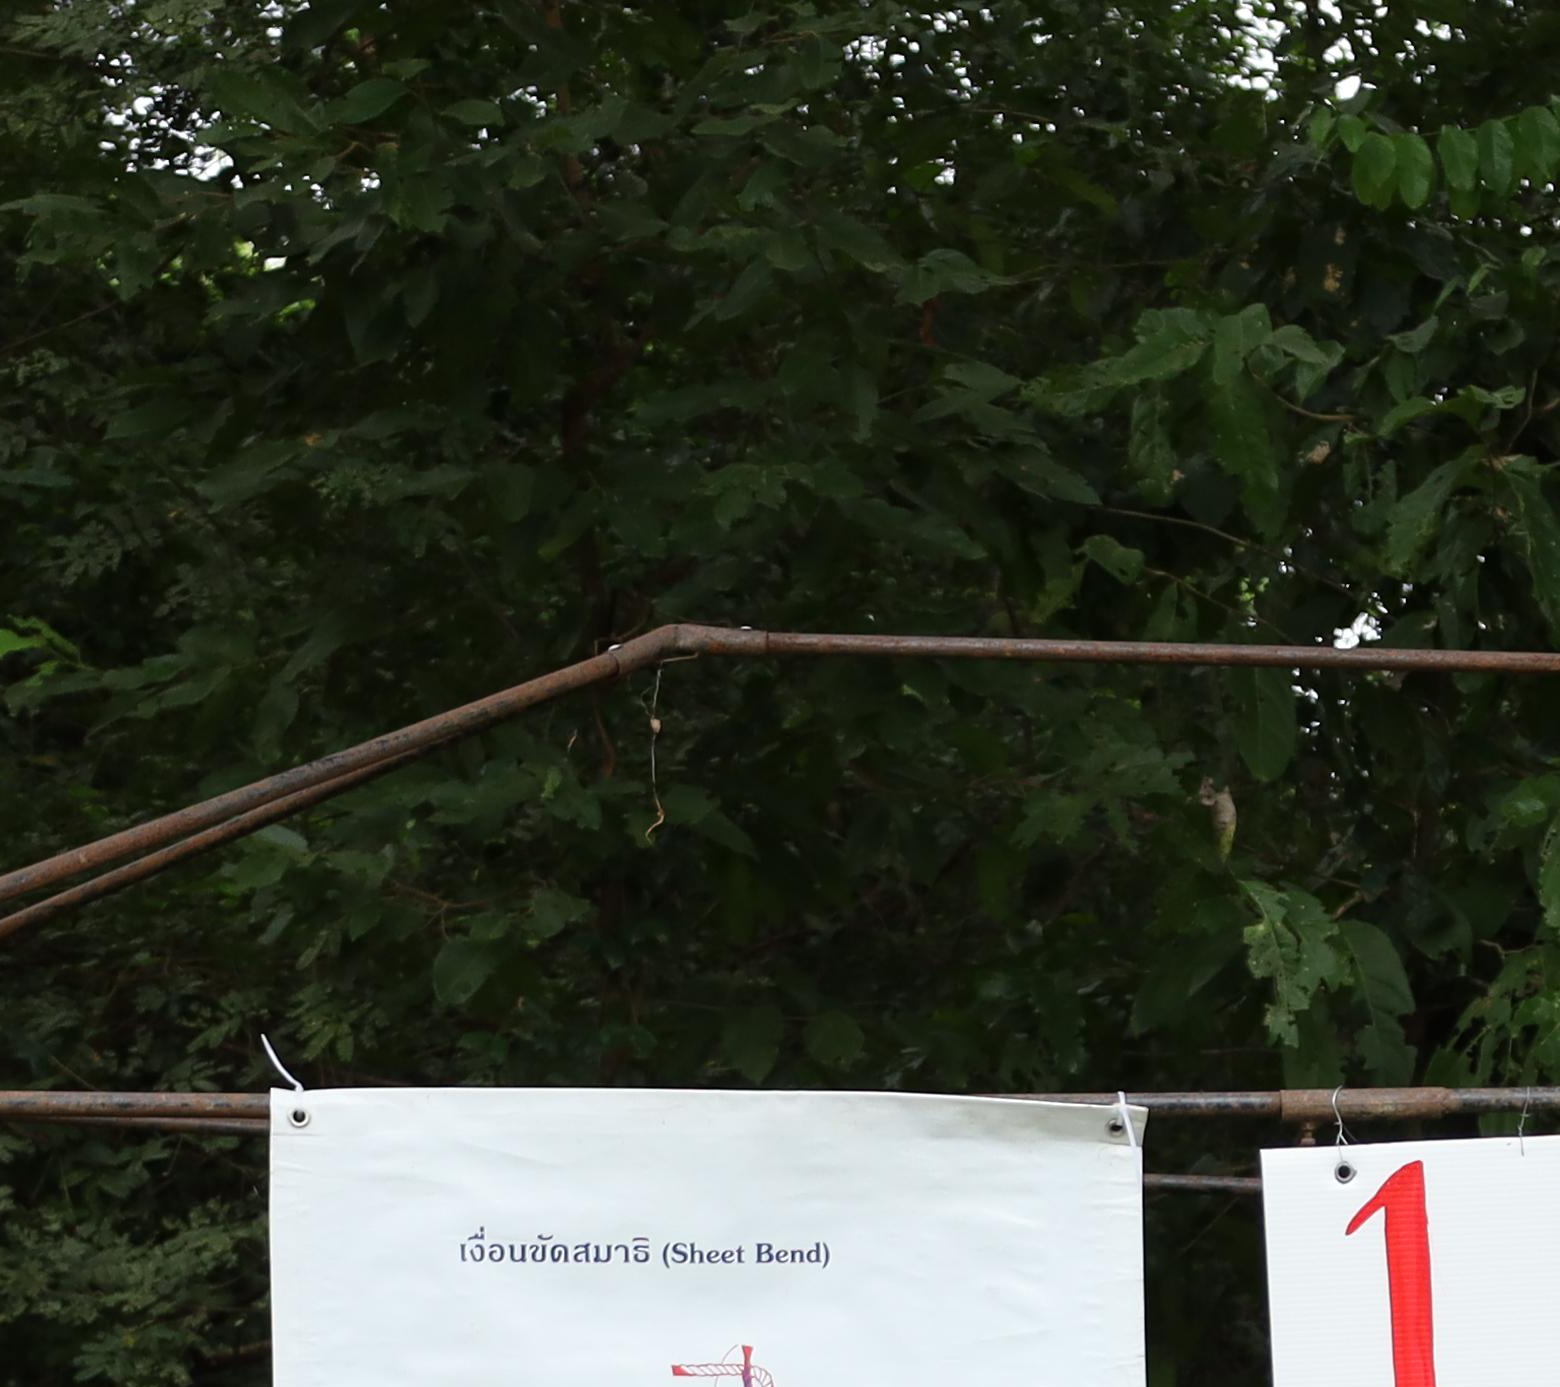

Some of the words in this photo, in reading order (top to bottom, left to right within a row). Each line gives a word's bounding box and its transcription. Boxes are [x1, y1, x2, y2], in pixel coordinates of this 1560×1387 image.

[460, 1226, 651, 1264] เงื่อนขัดสมาธิ
[662, 1241, 746, 1269] (Sheet
[755, 1241, 831, 1269] Bend)
